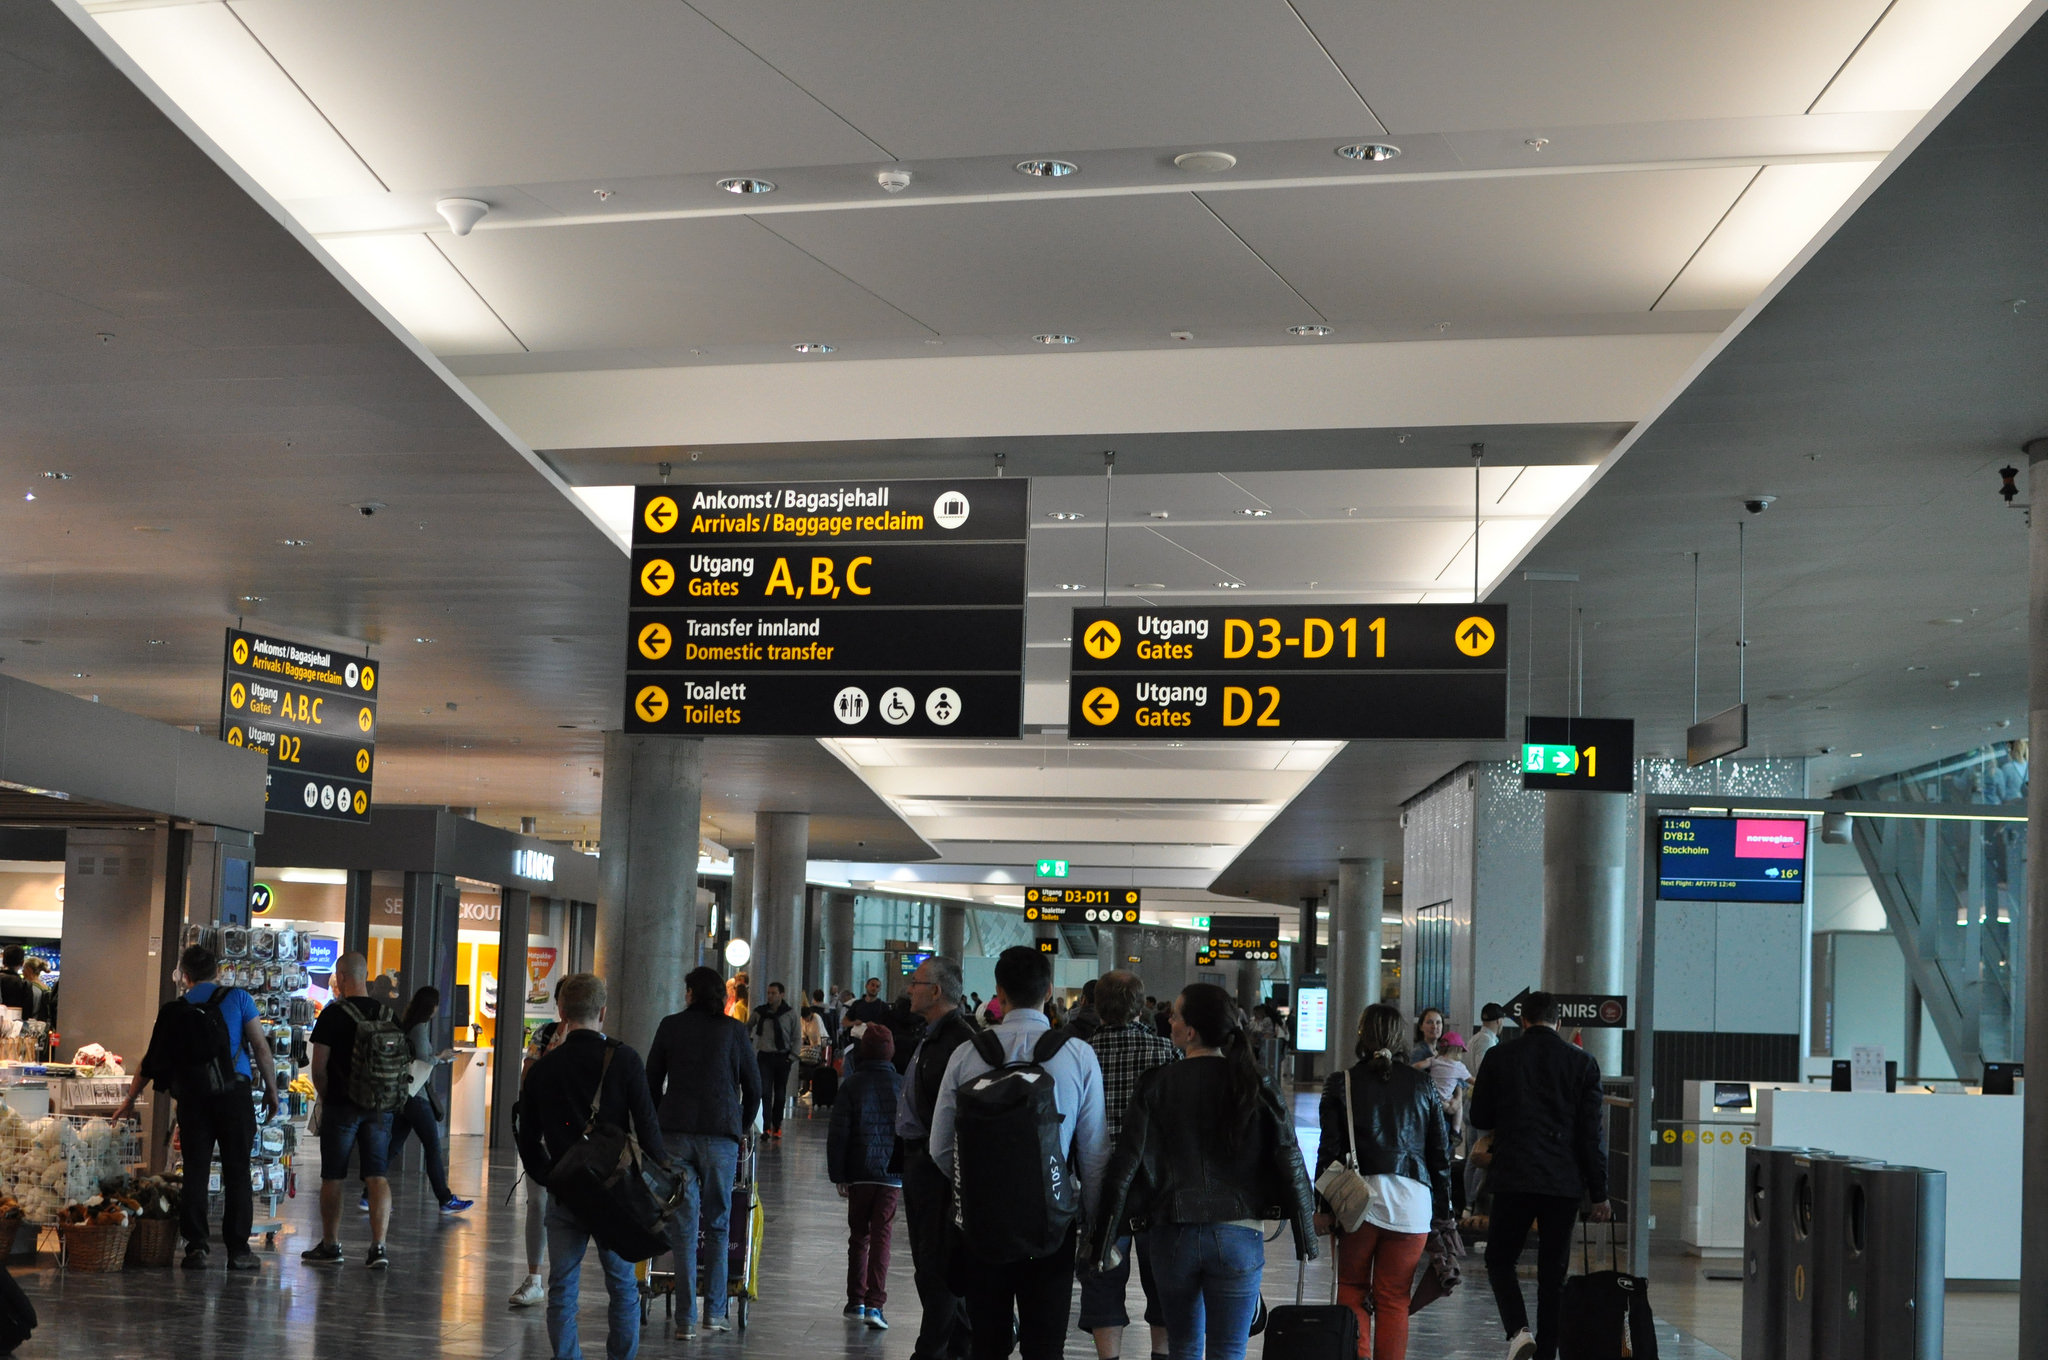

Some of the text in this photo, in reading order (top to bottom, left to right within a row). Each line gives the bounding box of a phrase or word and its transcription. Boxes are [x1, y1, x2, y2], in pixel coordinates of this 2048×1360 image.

[692, 489, 773, 510] Ankomst
[784, 486, 890, 513] Bagasjehall
[691, 512, 761, 533] Arrivals
[773, 513, 853, 537] Baggage
[855, 510, 924, 531] reclaim
[689, 554, 755, 578] Utgang
[688, 577, 740, 597] Gates
[686, 617, 820, 637] Transfer innland
[1137, 615, 1209, 640] Utgang
[1223, 617, 1386, 659] D3-D11
[253, 639, 287, 658] Ankomst
[290, 647, 331, 667] Bagasjehall
[685, 641, 835, 661] Domestic transfer
[1136, 639, 1193, 660] Gates
[252, 655, 282, 673] Arrivals
[285, 661, 317, 683] Baggage
[316, 670, 343, 686] reclaim
[250, 682, 279, 704] Utgang
[684, 680, 747, 701] Toalett
[1136, 682, 1208, 707] Utgang
[250, 699, 272, 715] Gates
[683, 704, 741, 724] Toilets
[1222, 685, 1281, 727] D2
[1135, 707, 1192, 727] Gates
[247, 725, 276, 747] Utgang
[279, 734, 301, 763] D2
[1664, 820, 1691, 829] 11:40
[1663, 832, 1695, 841] DY812
[1746, 835, 1794, 844] norwegian
[1662, 845, 1709, 855] Stockholm
[1675, 880, 1694, 888] Flight:
[1065, 890, 1110, 903] D3-D11
[1041, 943, 1052, 952] D4
